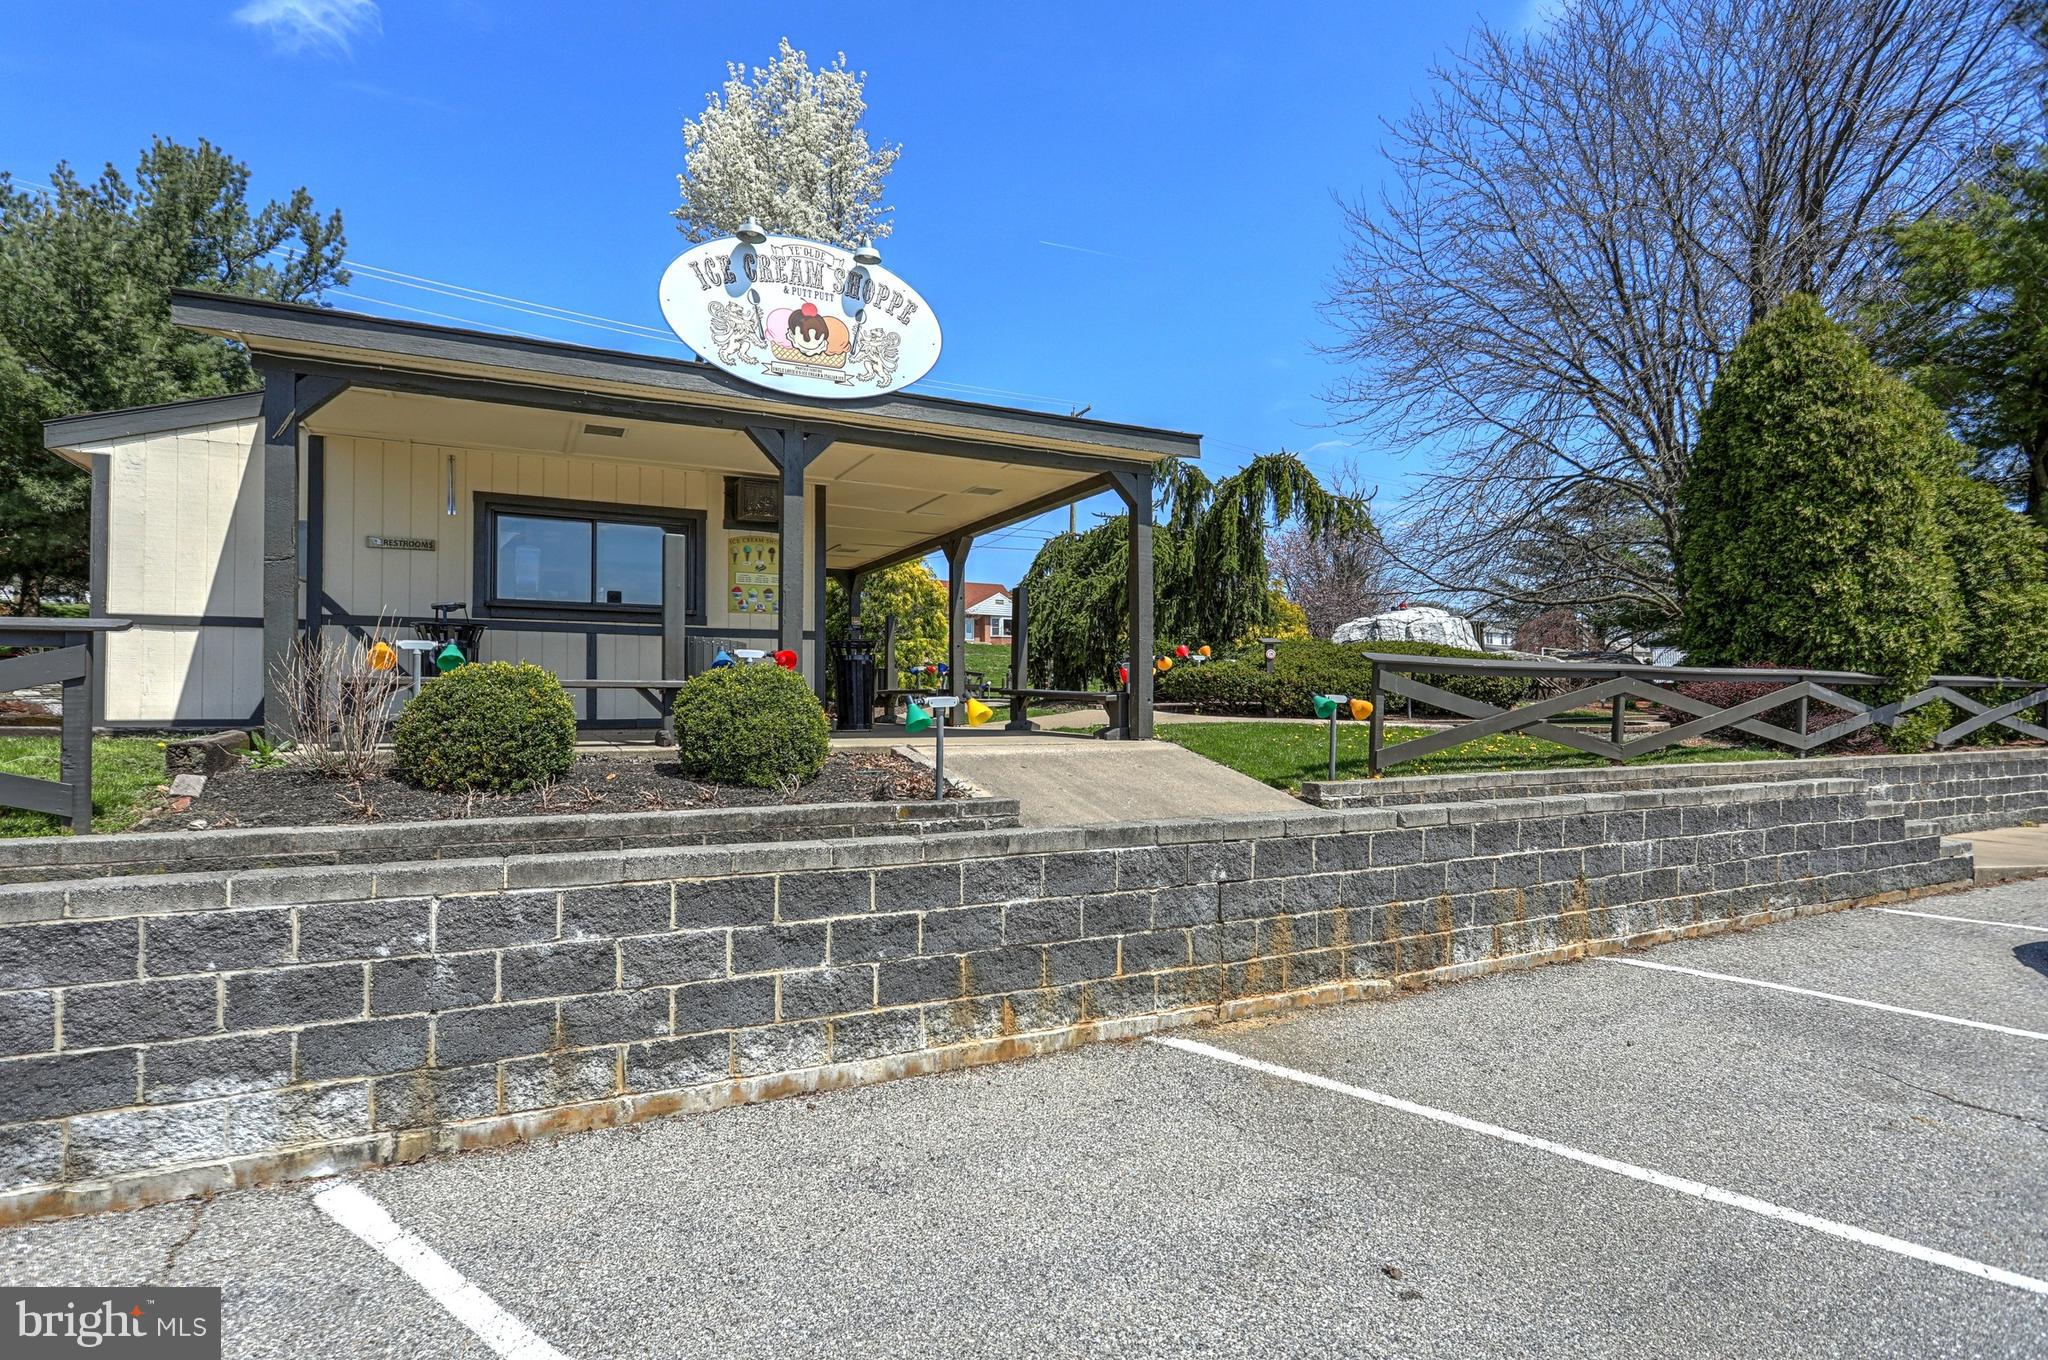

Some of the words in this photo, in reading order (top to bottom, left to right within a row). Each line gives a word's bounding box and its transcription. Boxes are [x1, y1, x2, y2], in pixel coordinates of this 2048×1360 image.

[804, 247, 825, 260] OLDE
[688, 255, 736, 291] ICE
[743, 253, 825, 290] CREAM
[833, 267, 918, 326] SHOPPE
[784, 286, 790, 295] &
[791, 287, 814, 299] PUTT
[815, 291, 835, 302] PUTT
[383, 539, 433, 549] RESTROOMS
